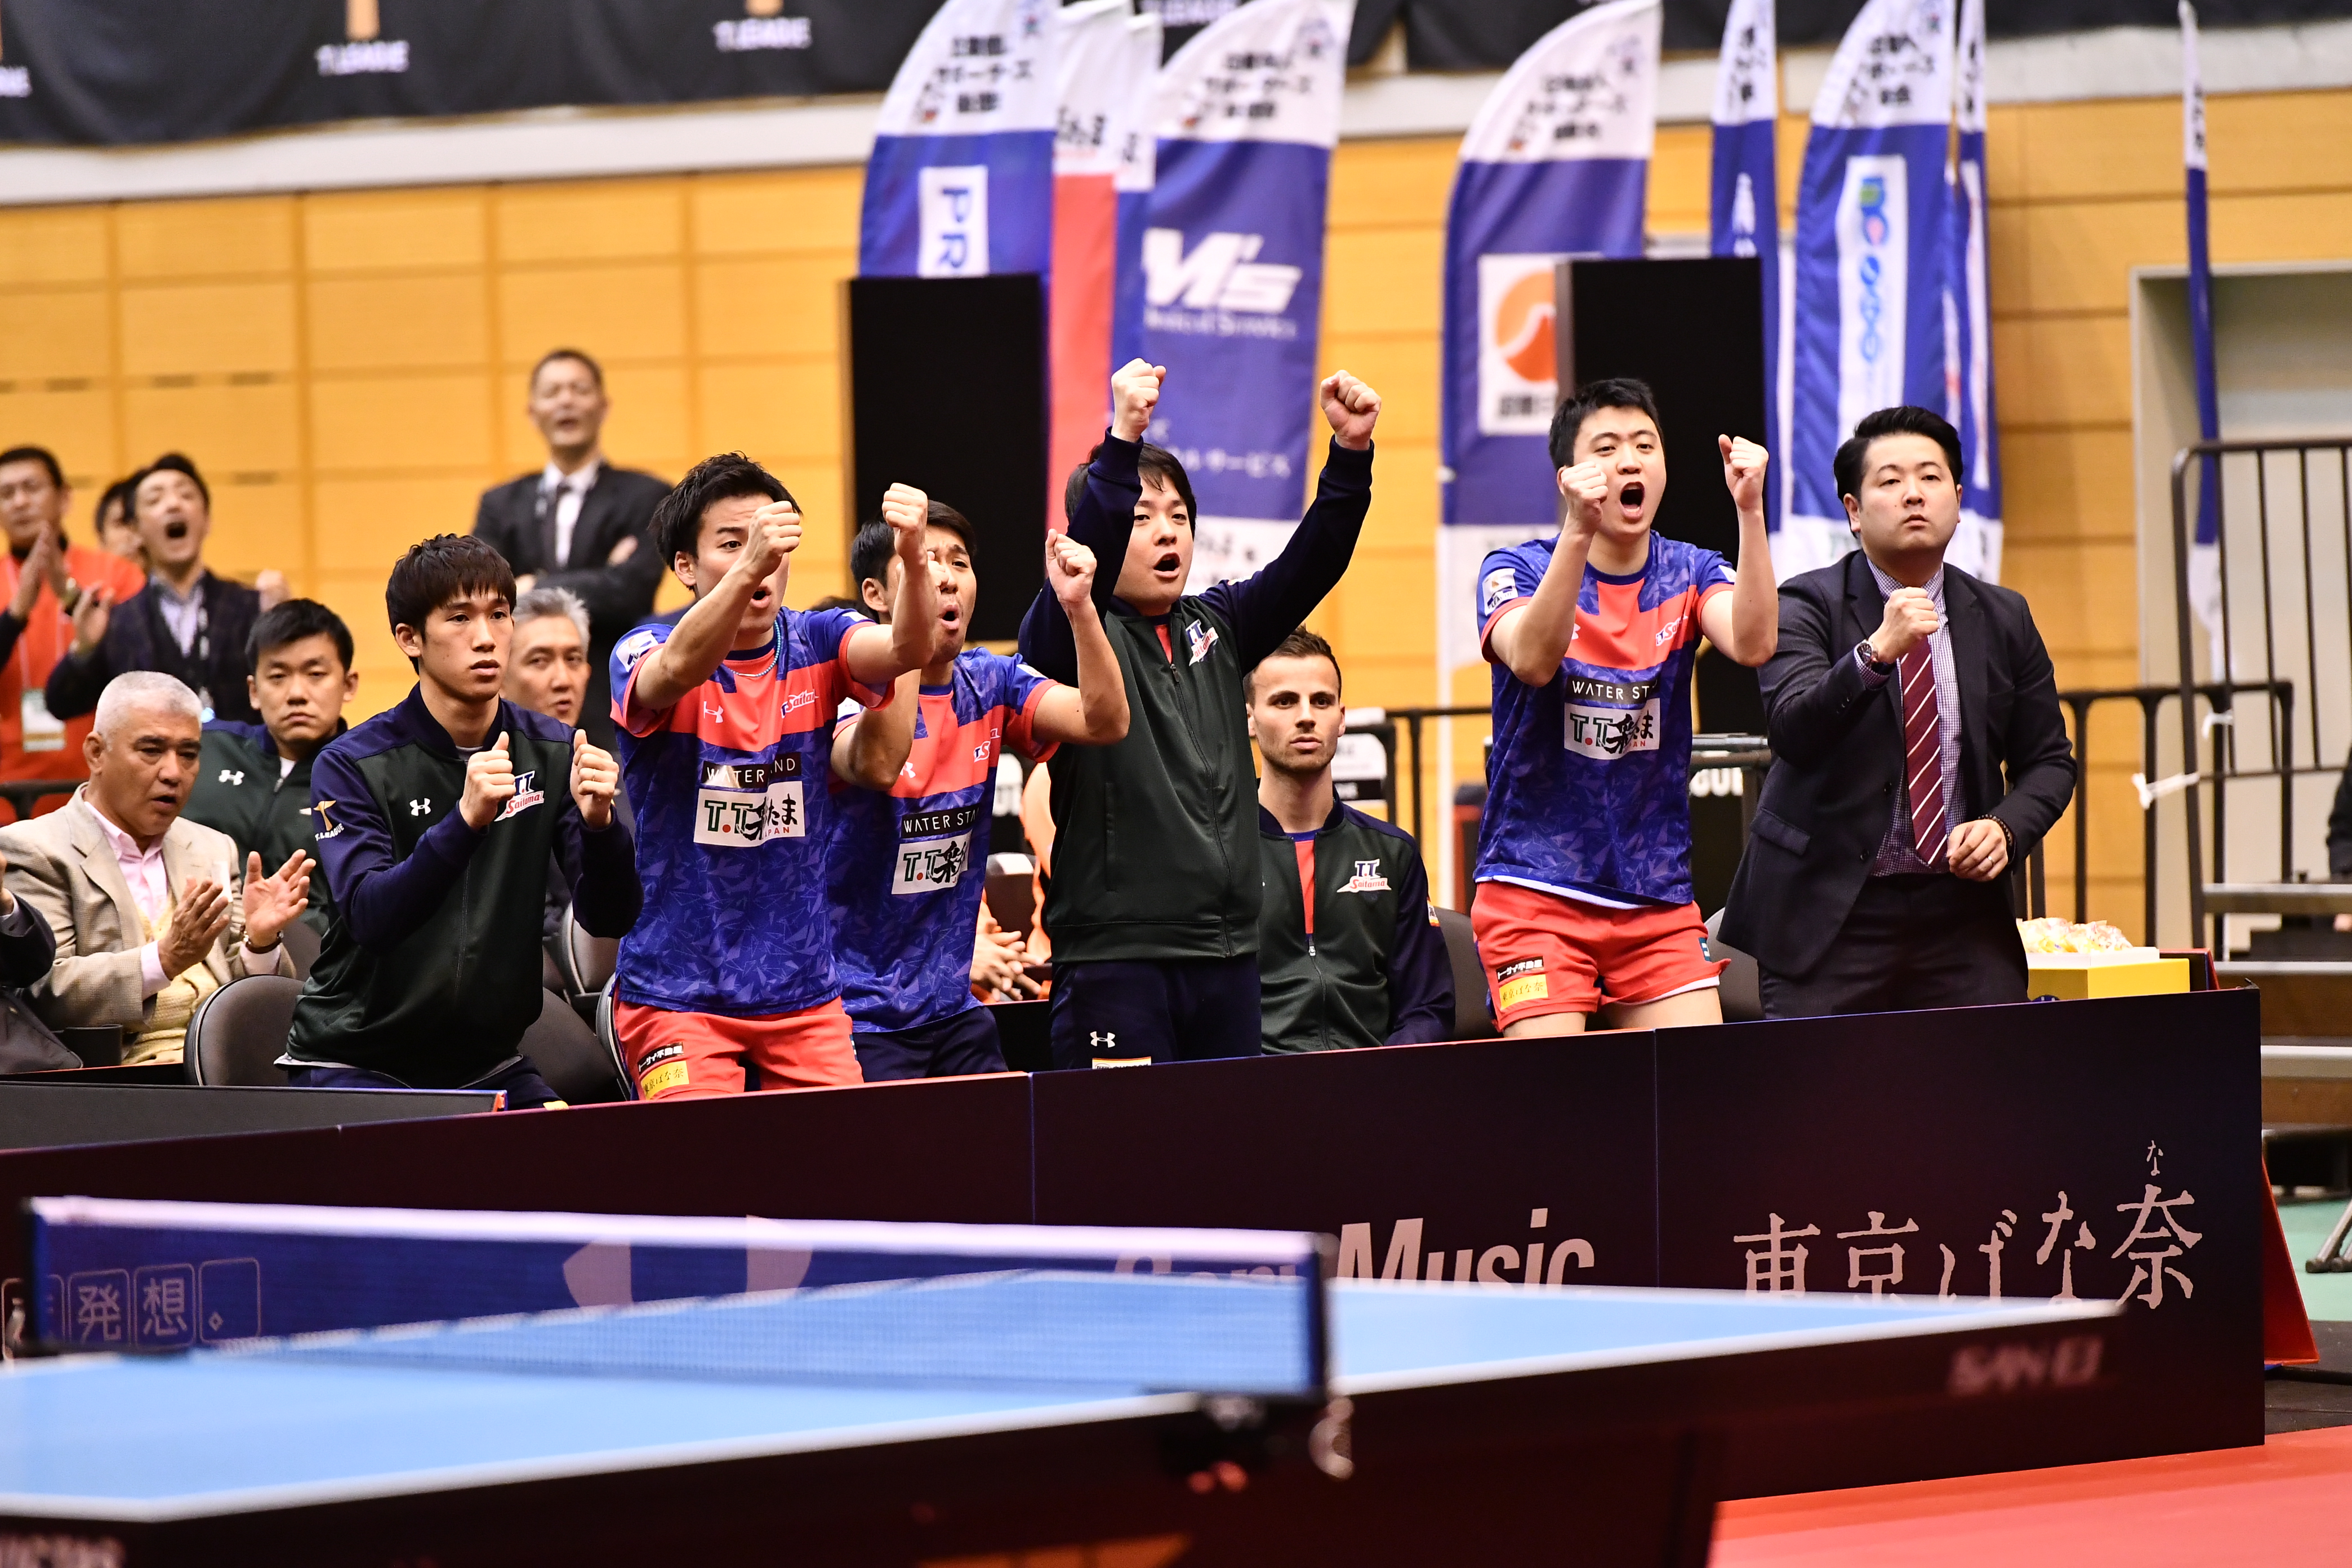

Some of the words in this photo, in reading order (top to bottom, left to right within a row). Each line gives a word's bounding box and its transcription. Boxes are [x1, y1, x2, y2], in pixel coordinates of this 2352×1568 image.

[1193, 631, 1214, 658] aitama
[1572, 680, 1624, 700] WATER
[1632, 683, 1652, 699] ST
[707, 766, 765, 783] WATER
[506, 794, 541, 814] Saitama
[314, 822, 345, 842] T.LEAGUE
[903, 814, 951, 833] WATER
[1349, 879, 1386, 889] Saitama
[1733, 1184, 2203, 1309] 東京ばな奈
[56, 1276, 225, 1345] 発想。
